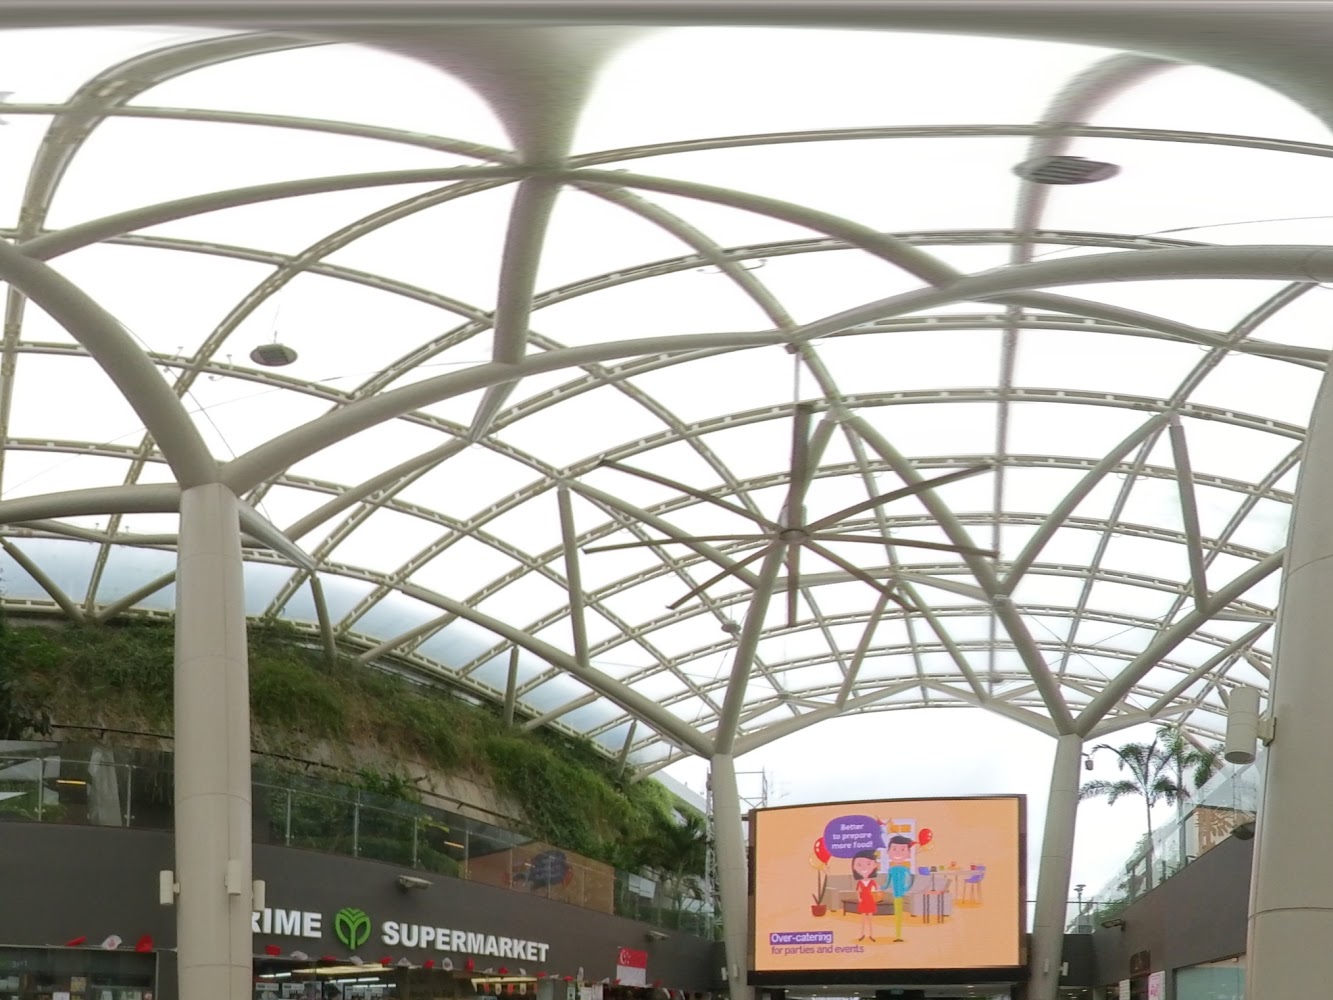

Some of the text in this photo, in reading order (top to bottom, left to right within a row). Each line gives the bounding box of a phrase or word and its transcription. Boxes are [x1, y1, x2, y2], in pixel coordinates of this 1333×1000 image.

[842, 832, 871, 840] prepare
[381, 920, 549, 962] SUPERMARKET
[771, 933, 832, 943] Over-catering
[771, 944, 864, 956] for parties and events
